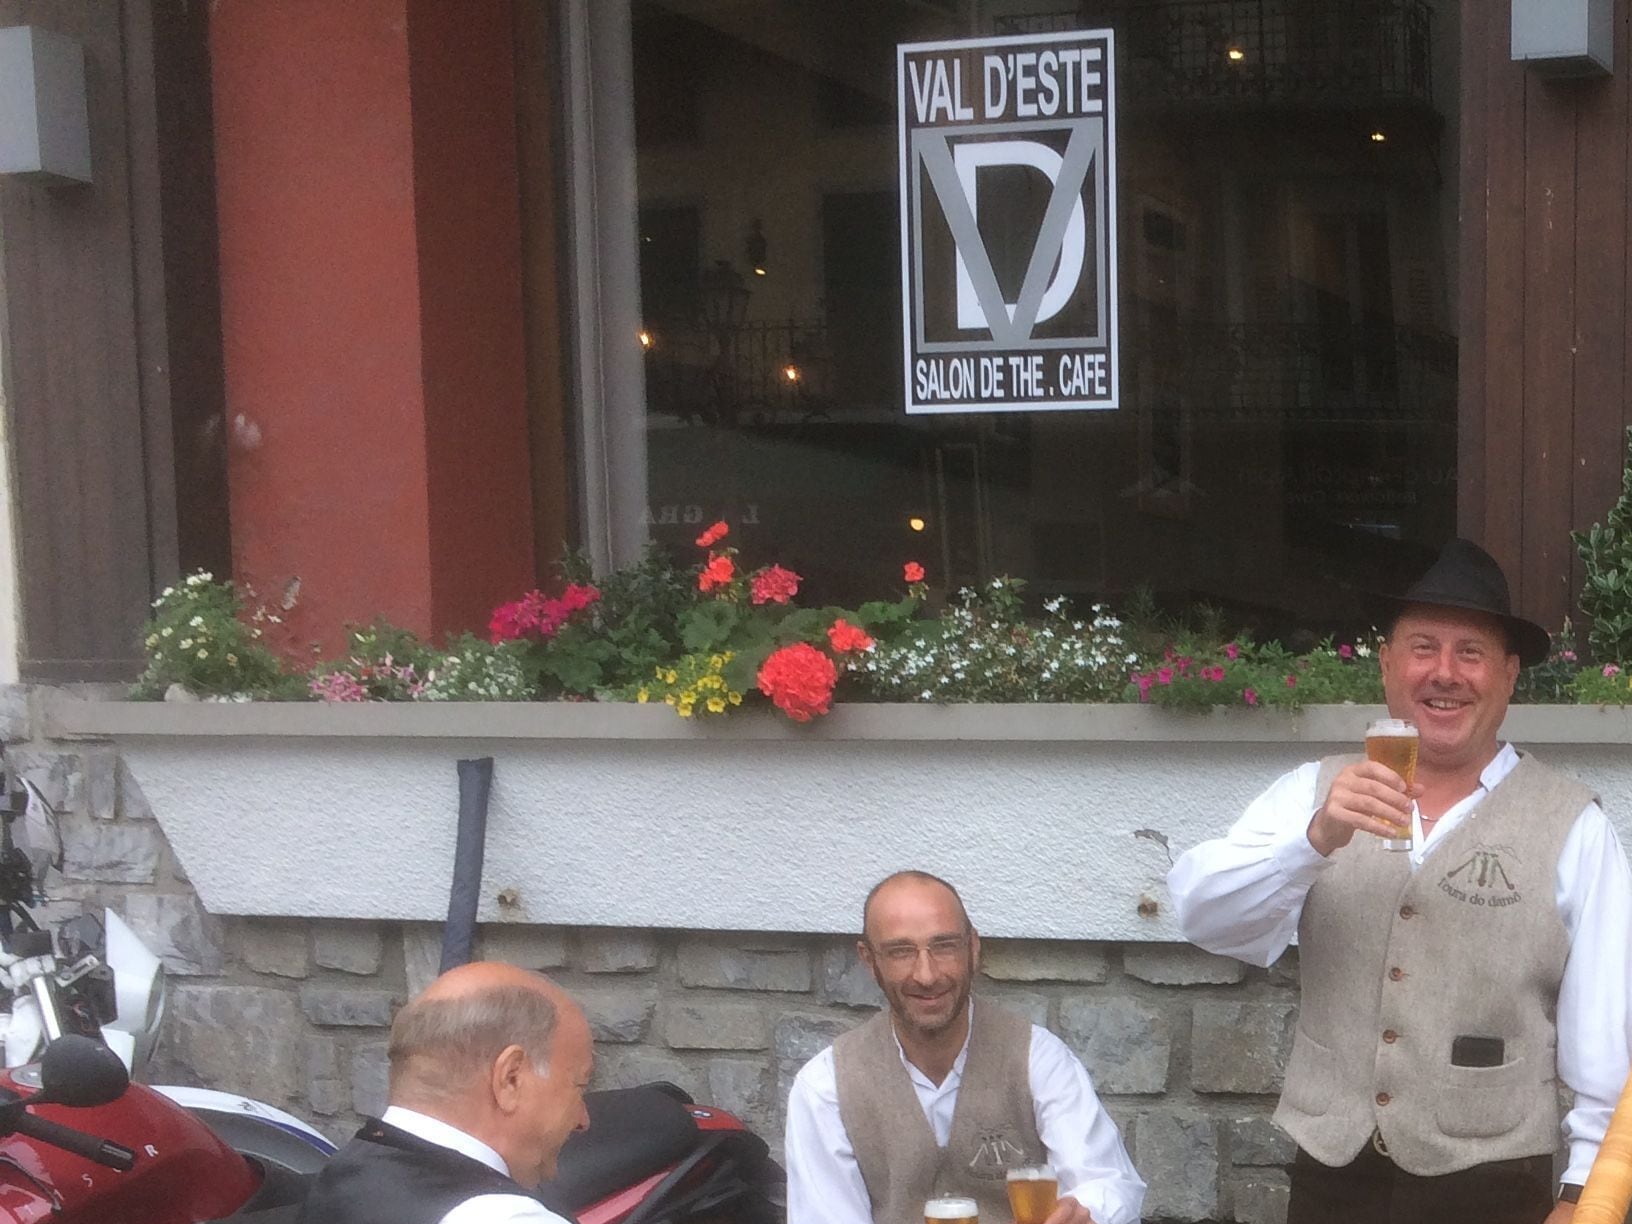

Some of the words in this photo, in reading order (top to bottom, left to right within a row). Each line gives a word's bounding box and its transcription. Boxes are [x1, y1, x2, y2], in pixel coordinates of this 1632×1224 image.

[909, 57, 974, 124] VAL
[983, 47, 1102, 119] D'ESTE
[916, 358, 975, 400] SALON
[980, 357, 1005, 398] DE
[1009, 355, 1044, 397] THE
[1059, 354, 1106, 396] CAFE
